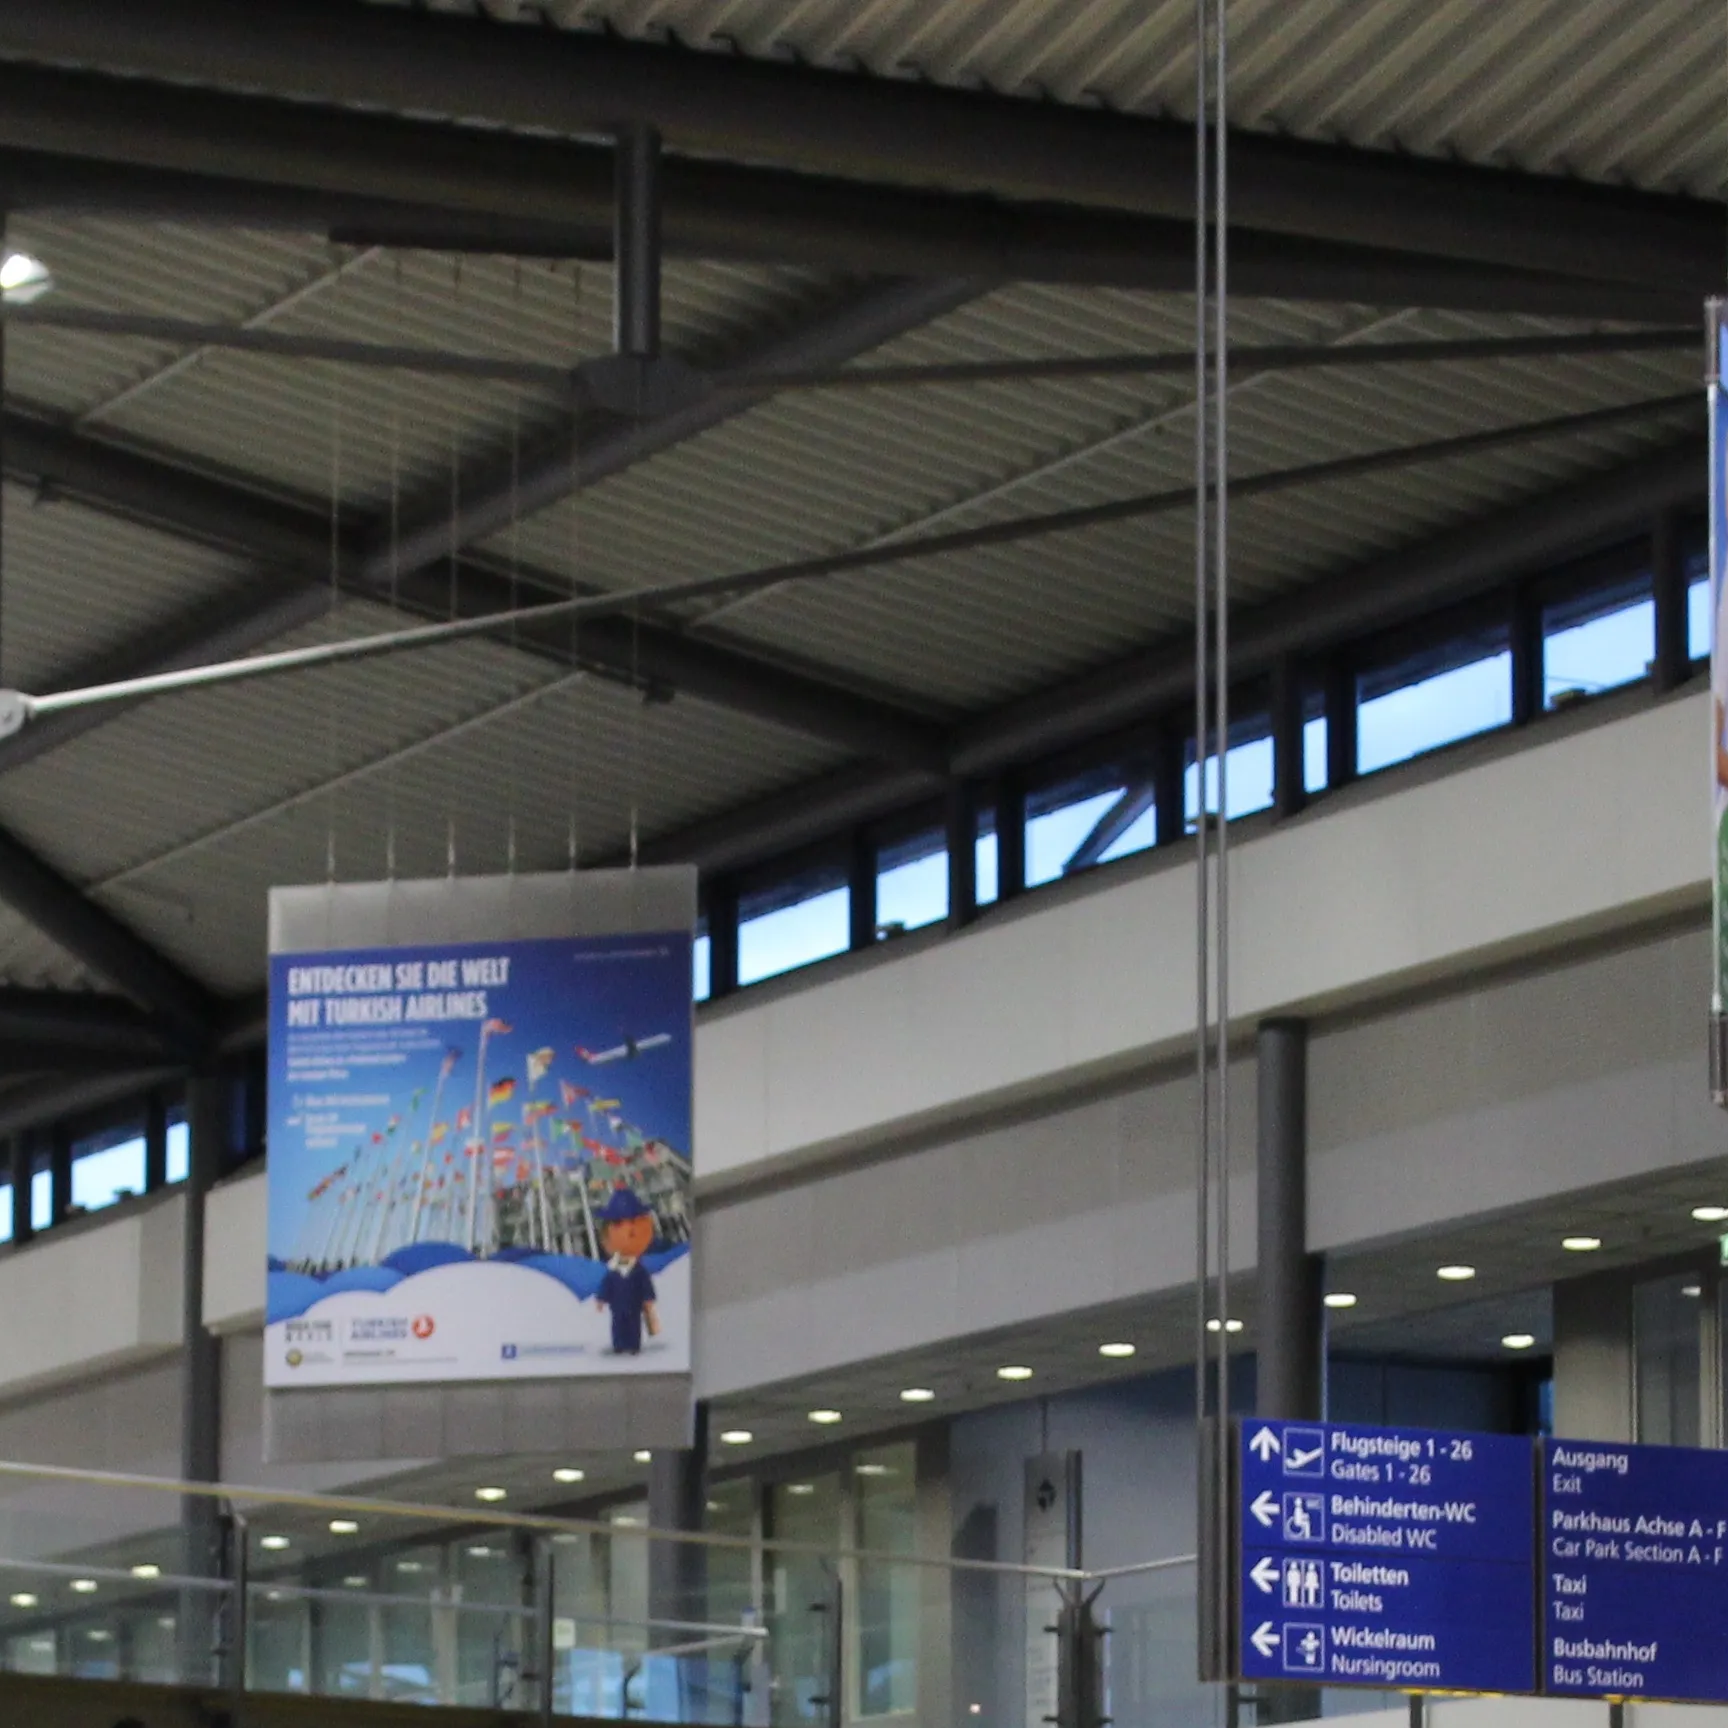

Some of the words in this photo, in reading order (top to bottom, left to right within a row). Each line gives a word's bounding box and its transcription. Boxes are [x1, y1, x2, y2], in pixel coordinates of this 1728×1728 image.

[288, 964, 393, 995] ENTDECKEN
[396, 962, 422, 990] SIE
[427, 960, 457, 988] DIE
[461, 957, 510, 987] WELT
[287, 999, 320, 1027] MIT
[325, 996, 403, 1025] TURKISH
[405, 990, 488, 1021] AIRLINES
[1331, 1432, 1421, 1460] Flugsteige
[1427, 1439, 1436, 1457] 1
[1450, 1441, 1472, 1461] 26
[1331, 1460, 1379, 1483] Gates
[1386, 1464, 1394, 1482] 1
[1409, 1465, 1431, 1485] 26
[1553, 1448, 1629, 1474] Ausgang
[1553, 1473, 1582, 1495] Exit
[1331, 1495, 1476, 1523] Behinderten-WC
[1331, 1524, 1403, 1549] Disabled
[1407, 1528, 1437, 1550] WC
[1553, 1510, 1631, 1535] Parkhaus
[1636, 1517, 1685, 1538] Achse
[1689, 1519, 1704, 1538] A
[1717, 1520, 1727, 1539] F
[1553, 1538, 1581, 1558] Car
[1585, 1539, 1621, 1560] Park
[1625, 1541, 1684, 1564] Section
[1687, 1545, 1702, 1563] A
[1714, 1546, 1724, 1565] F
[1331, 1562, 1409, 1587] Toiletten
[1553, 1574, 1587, 1595] Taxi
[1331, 1589, 1383, 1613] Toilets
[1553, 1600, 1585, 1621] Taxi
[1331, 1627, 1436, 1652] Wickelraum
[1553, 1638, 1657, 1664] Busbahnhof
[1331, 1655, 1441, 1681] Nursingroom
[1553, 1665, 1583, 1686] Bus
[1587, 1667, 1644, 1689] Station
